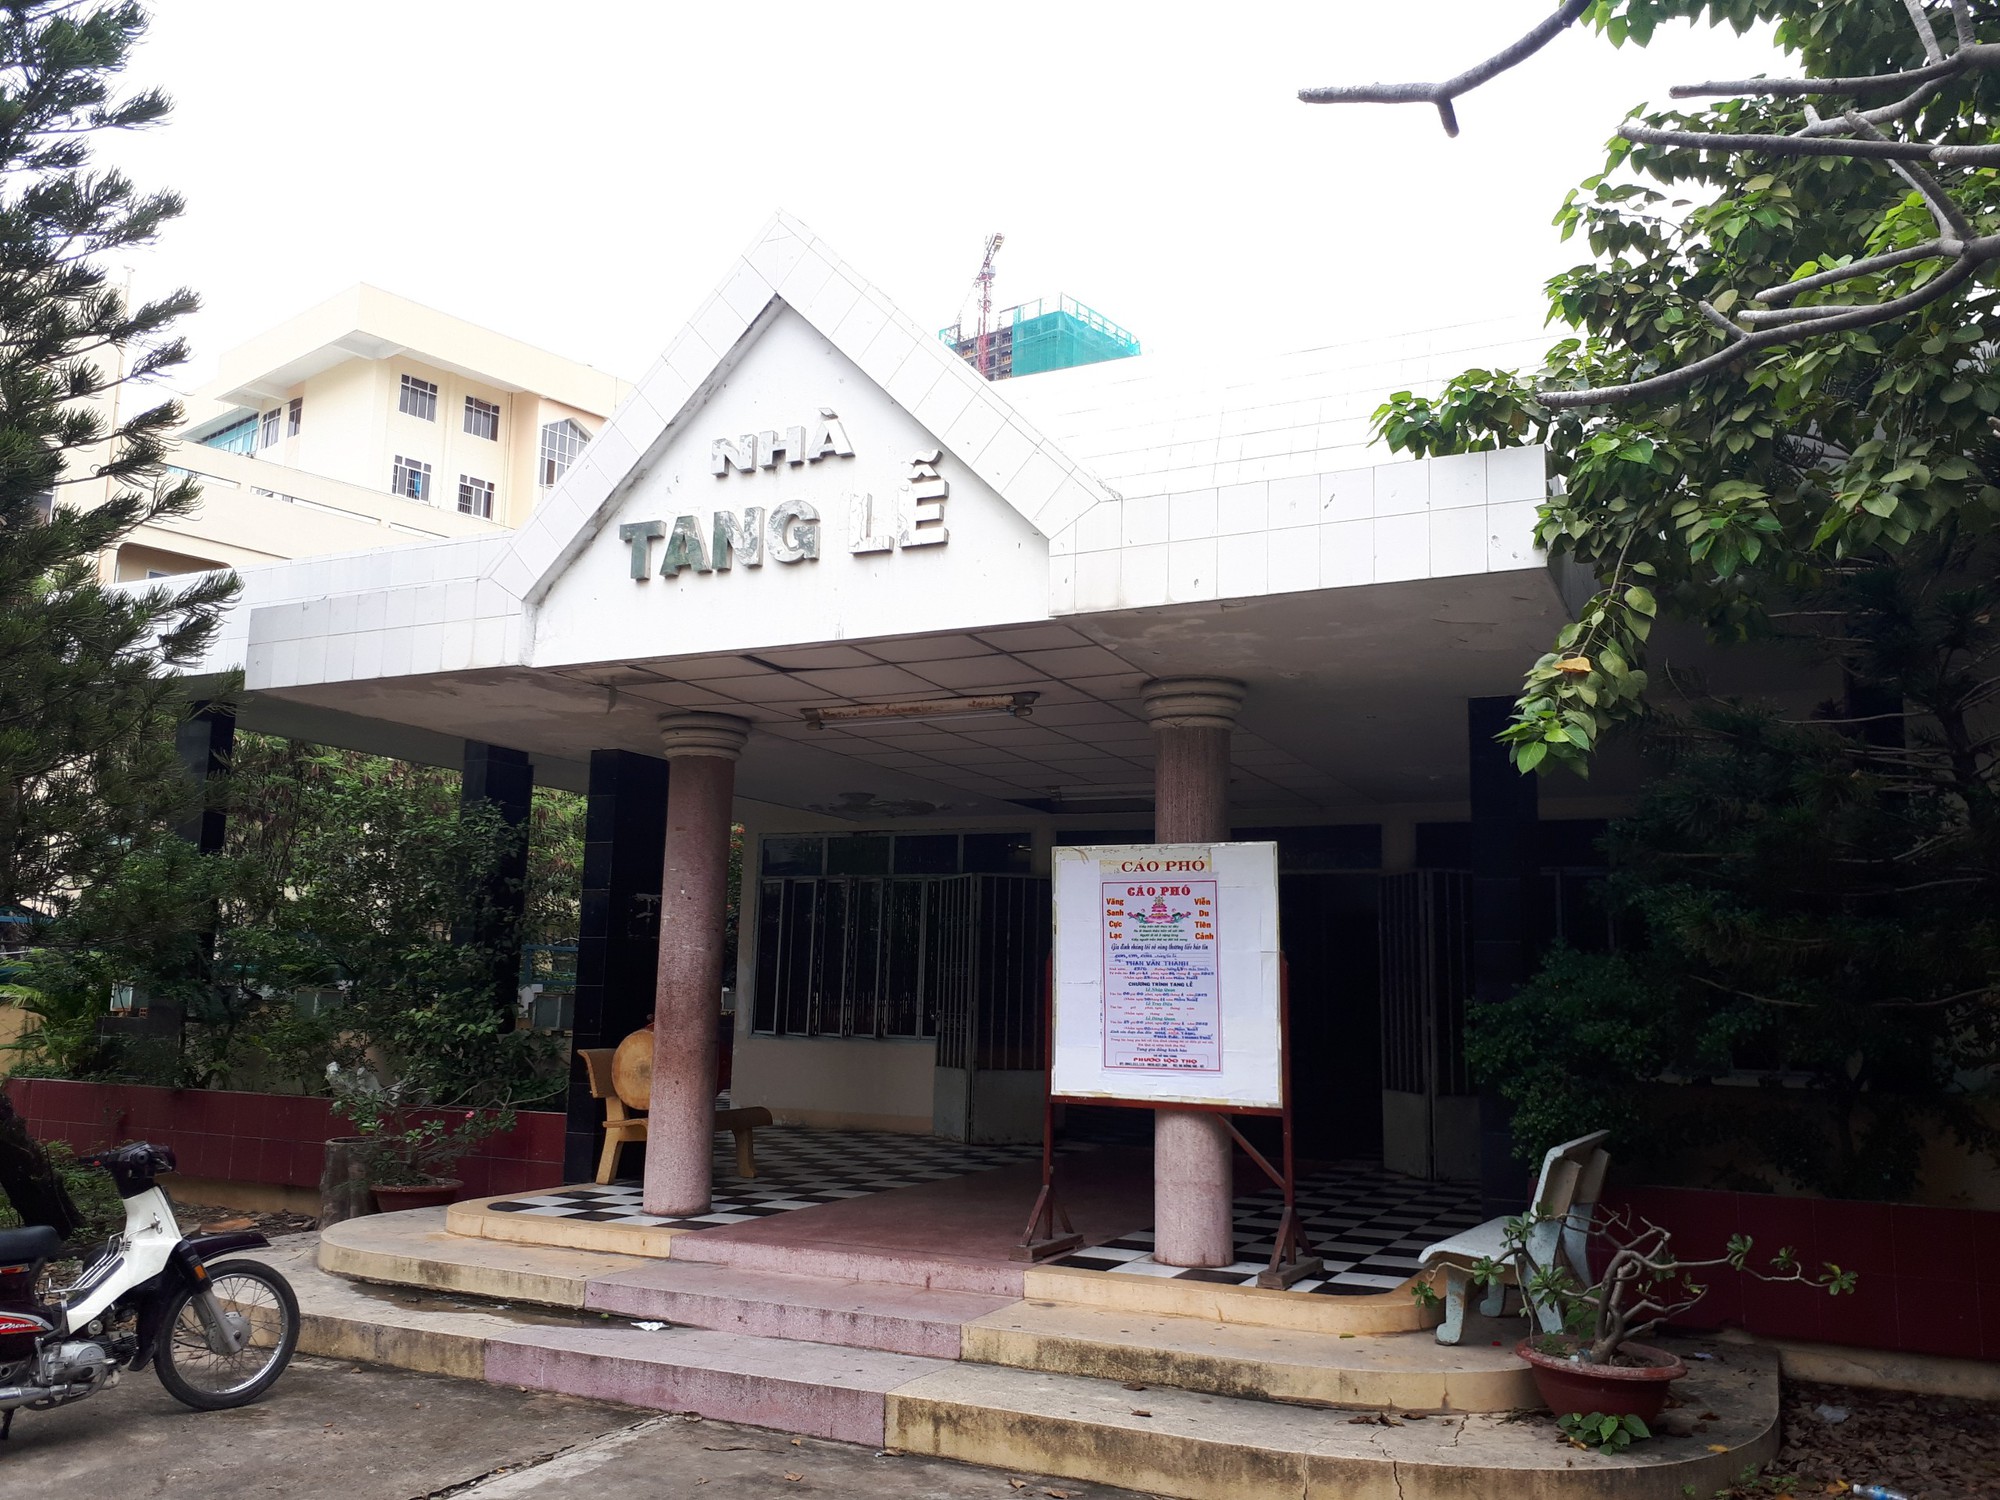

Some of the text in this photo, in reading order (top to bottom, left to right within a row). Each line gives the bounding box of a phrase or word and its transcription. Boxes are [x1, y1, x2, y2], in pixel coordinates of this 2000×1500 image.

[711, 408, 855, 477] NHÀ
[619, 449, 949, 582] TANG LỄ
[1121, 856, 1205, 872] CÁO PHÓ
[1127, 885, 1191, 896] CÁO PHÓ
[1109, 932, 1122, 940] Lạc
